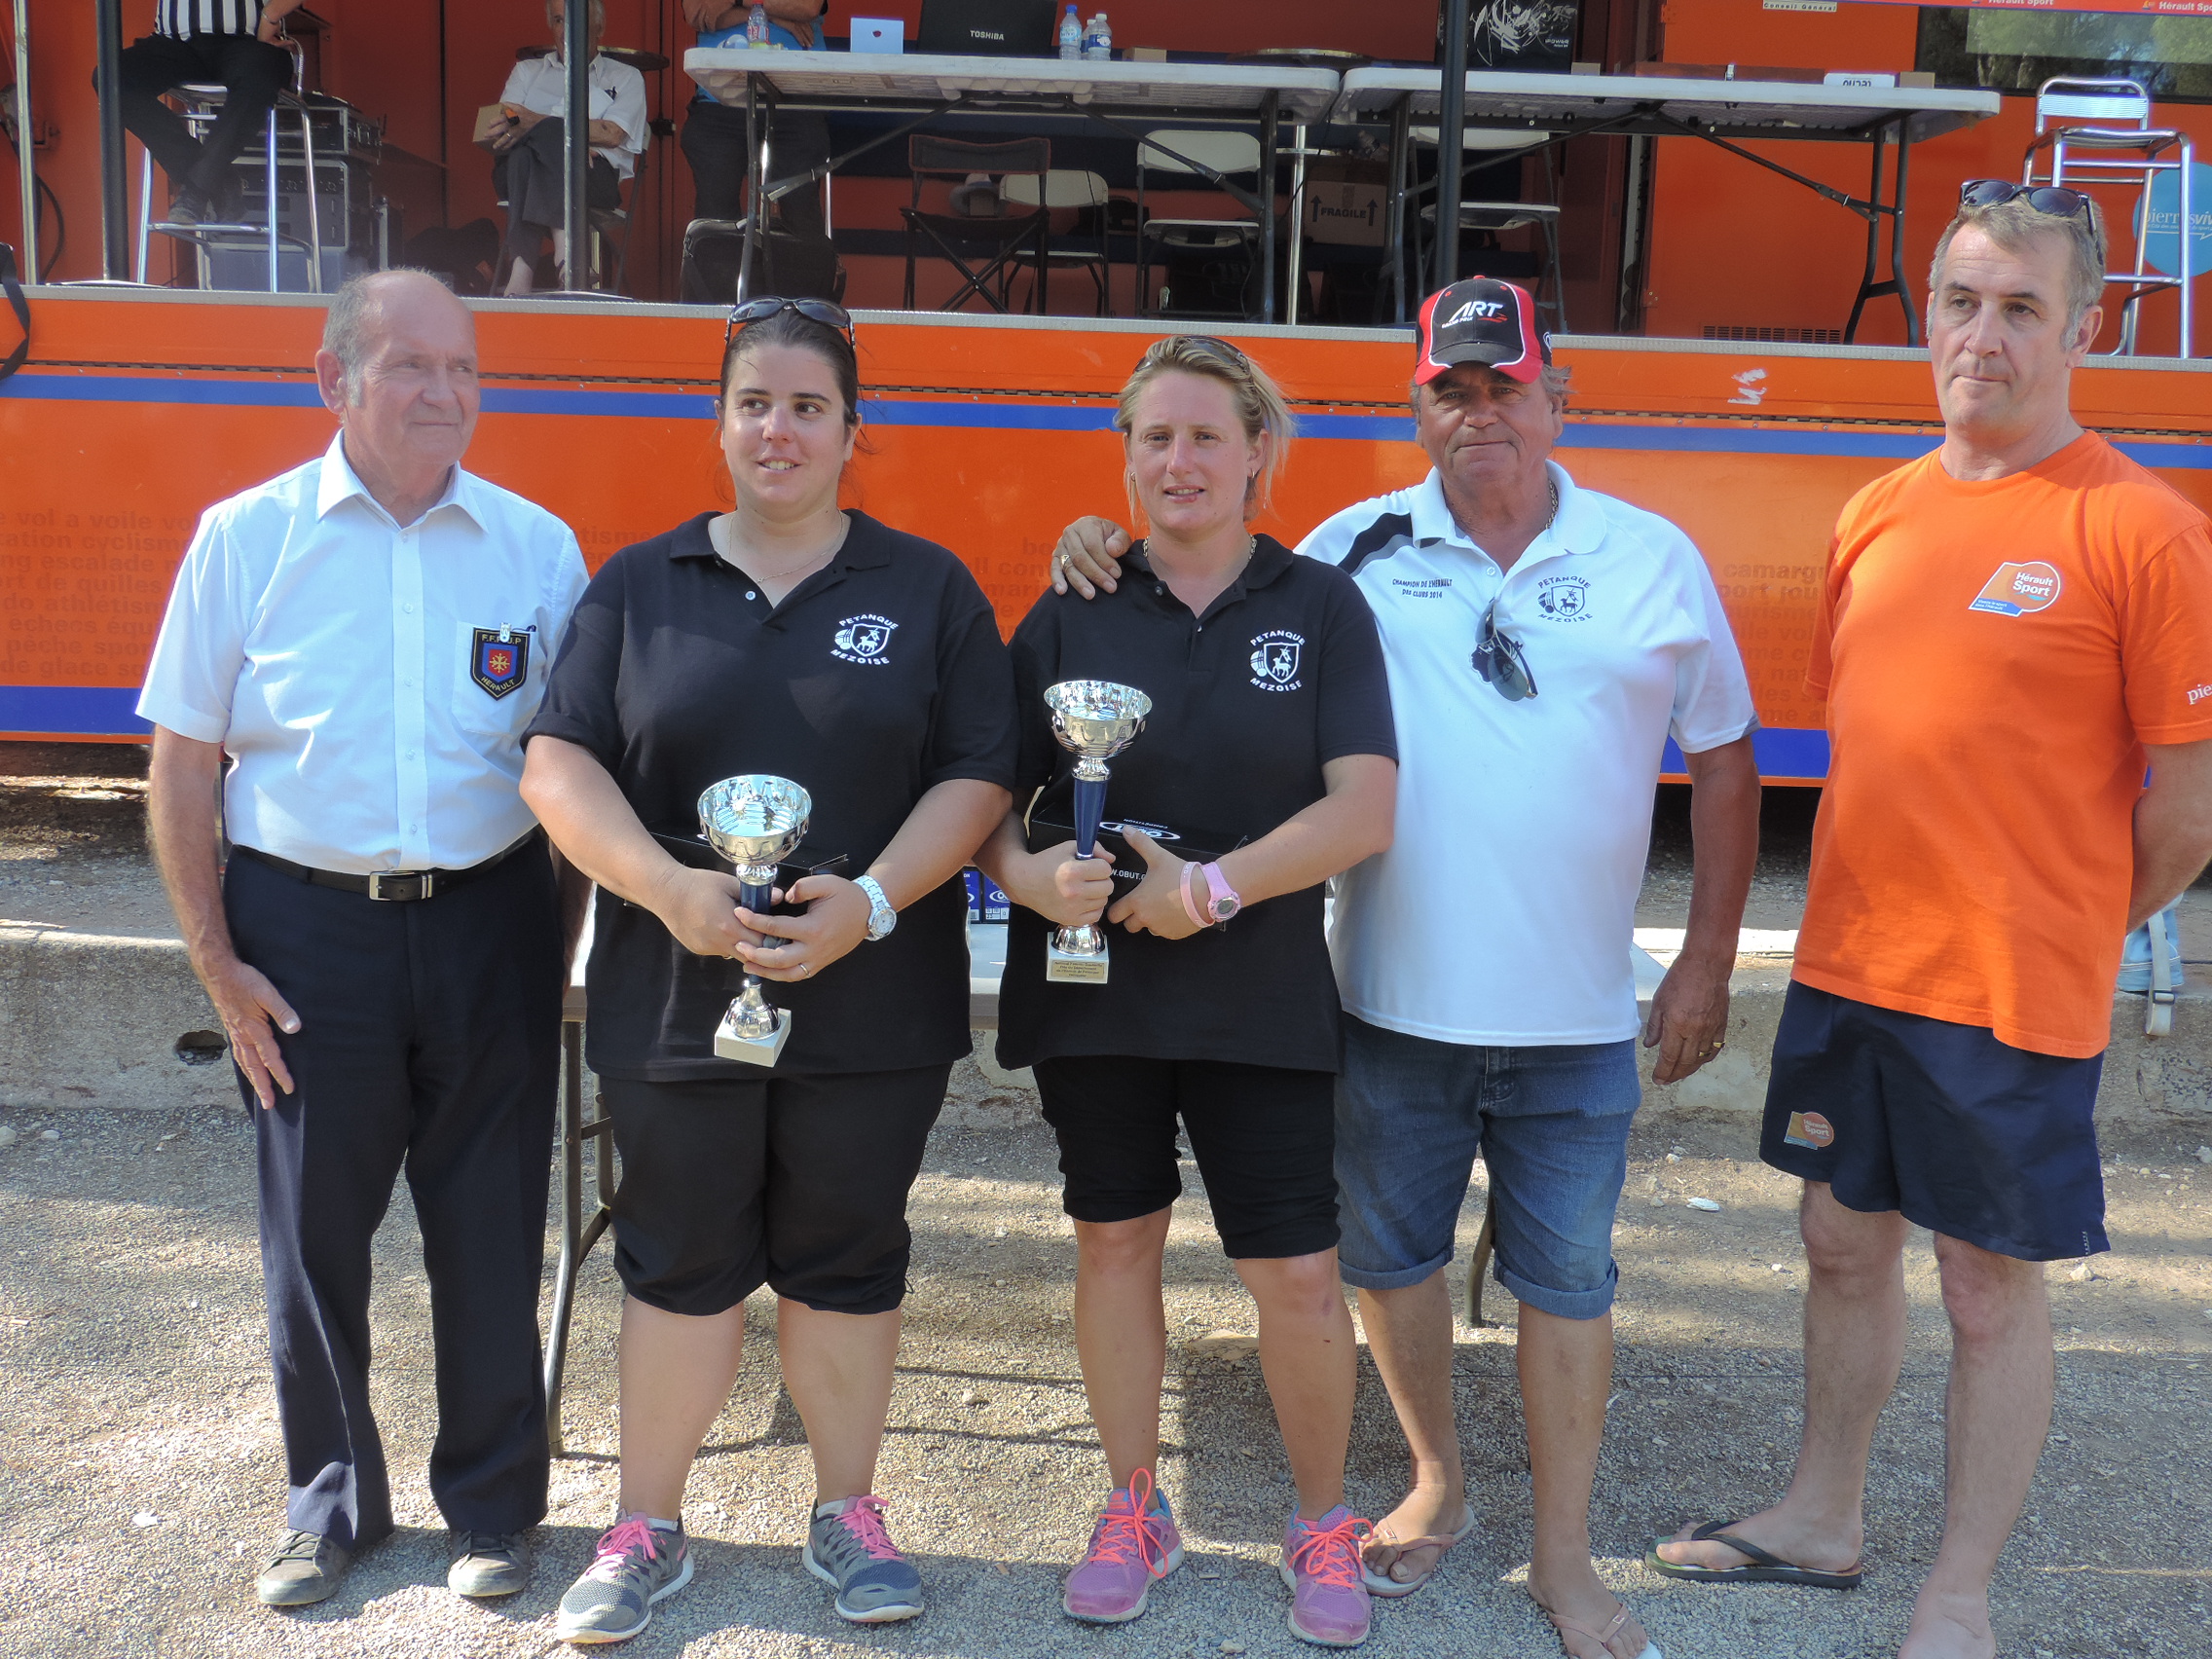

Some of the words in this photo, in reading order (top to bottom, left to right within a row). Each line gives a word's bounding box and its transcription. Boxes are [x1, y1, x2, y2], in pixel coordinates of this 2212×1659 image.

[2159, 1, 2194, 11] Hérault
[970, 29, 1004, 41] TOSHIBA
[1320, 207, 1367, 219] FRAGILE
[1449, 300, 1503, 322] ART
[17, 507, 55, 528] vol
[65, 512, 80, 528] a
[90, 510, 152, 531] voile
[82, 533, 186, 552] cyclism
[41, 553, 155, 572] escalade
[36, 572, 67, 590] de
[77, 574, 163, 596] quilles
[1392, 578, 1420, 588] CHAMPION
[1537, 575, 1591, 589] PETANQUE
[2015, 571, 2053, 586] Hérault
[2012, 580, 2050, 597] Sport
[9, 612, 97, 634] échecs
[838, 613, 899, 630] PETANQUE
[1537, 612, 1593, 623] MEZOISE
[1249, 629, 1306, 646] PETANQUE
[6, 635, 83, 658] pêche
[830, 648, 890, 665] MEZOISE
[39, 656, 108, 679] glace
[480, 676, 515, 691] HERAULT
[1249, 677, 1302, 692] MEZOISE
[1803, 1119, 1828, 1129] Hérault
[1804, 1124, 1830, 1137] Sport
